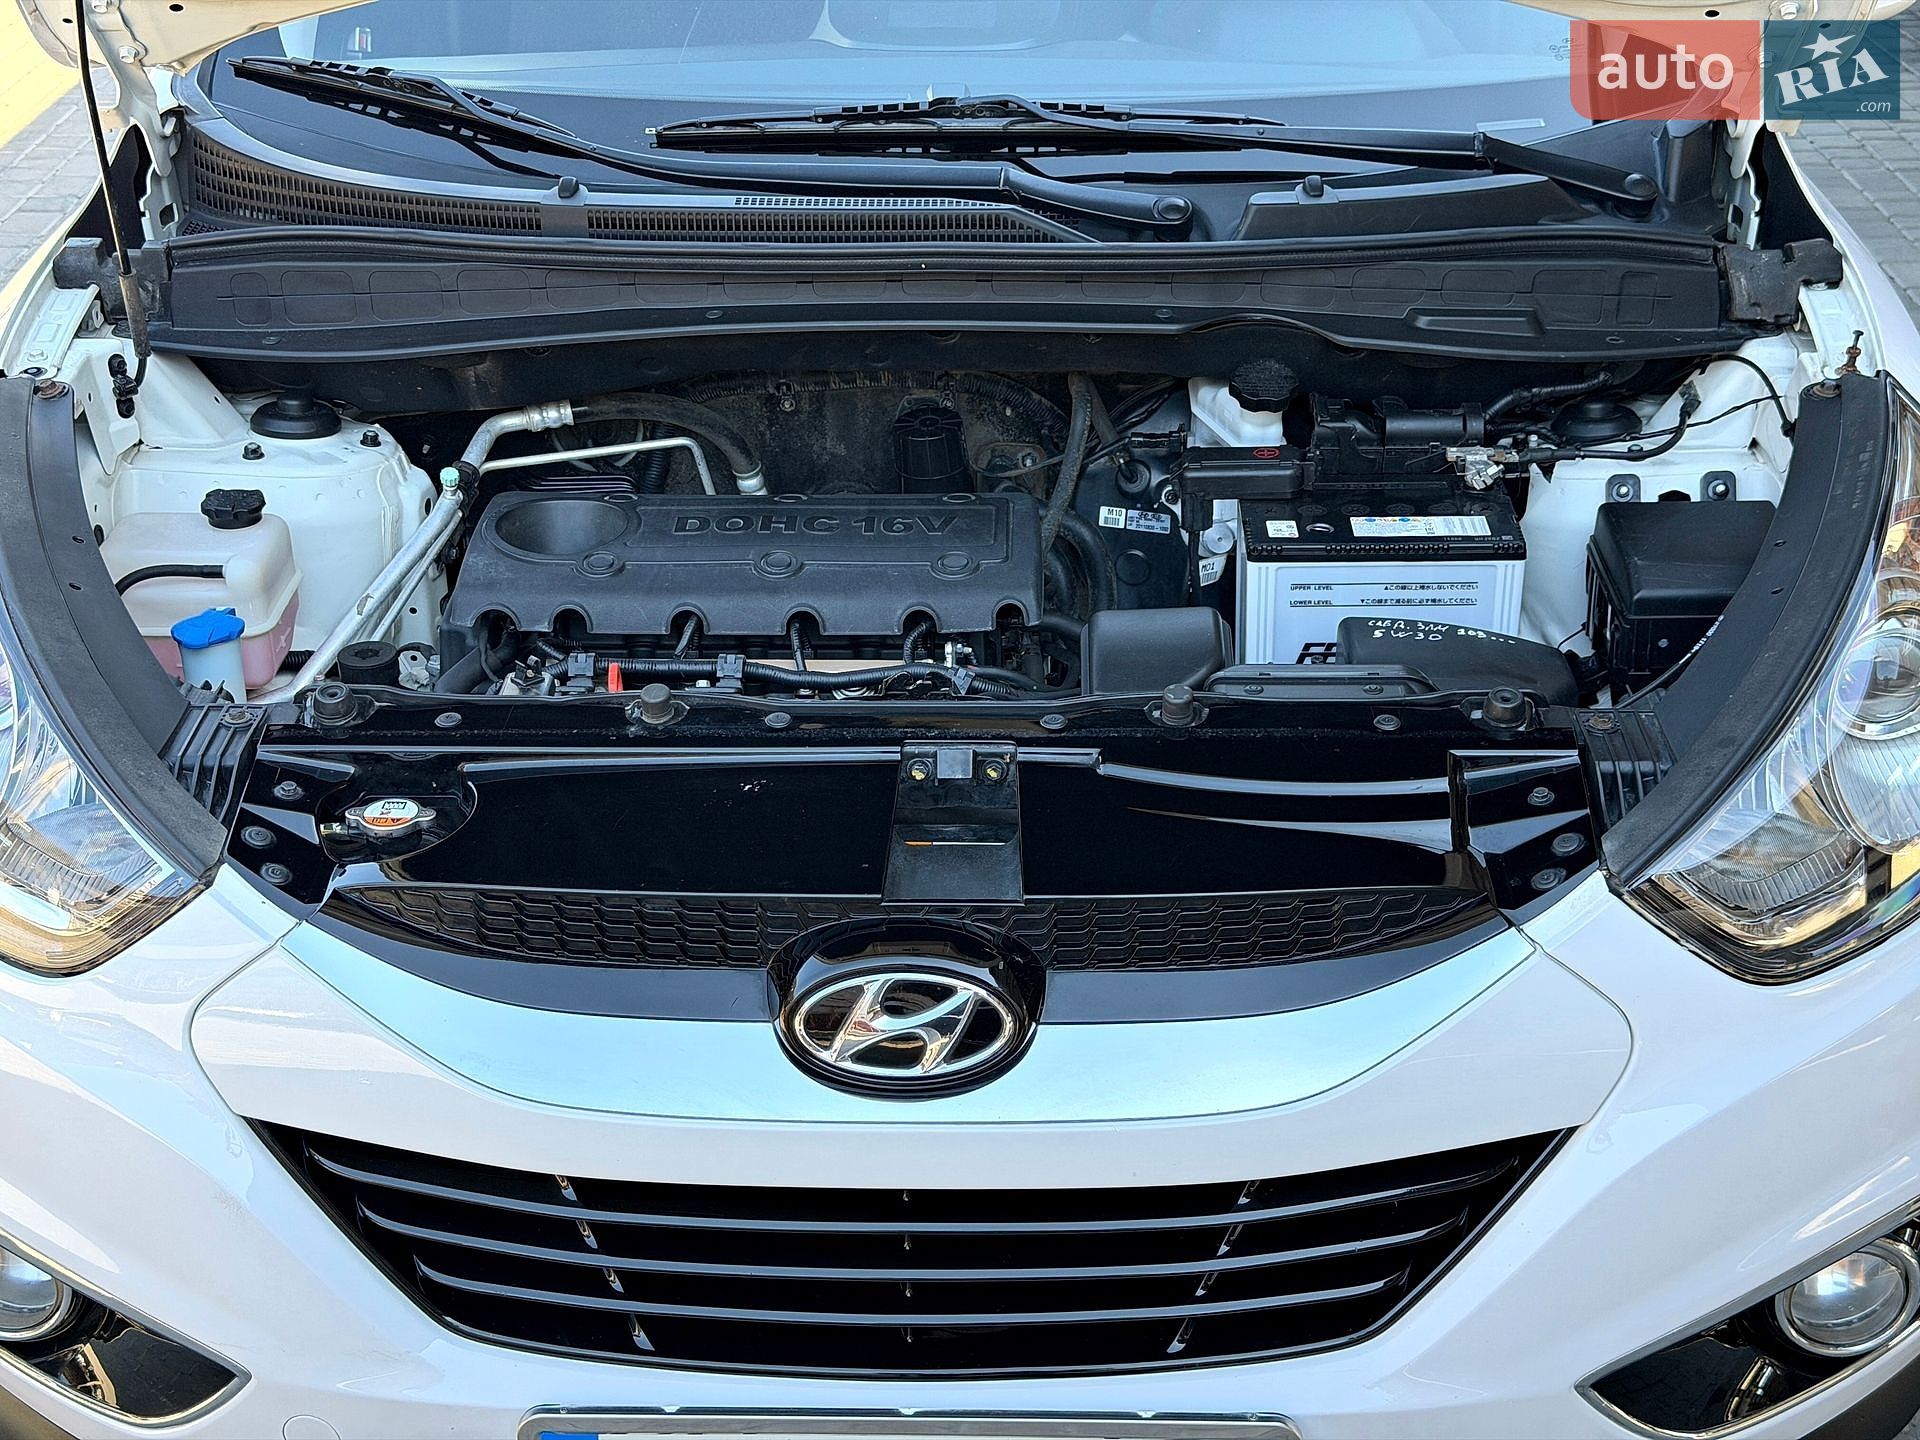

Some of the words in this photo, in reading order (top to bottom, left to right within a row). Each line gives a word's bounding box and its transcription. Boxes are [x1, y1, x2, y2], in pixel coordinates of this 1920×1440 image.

[1107, 508, 1123, 517] M10
[673, 515, 842, 535] DOHC
[851, 515, 959, 536] 16V
